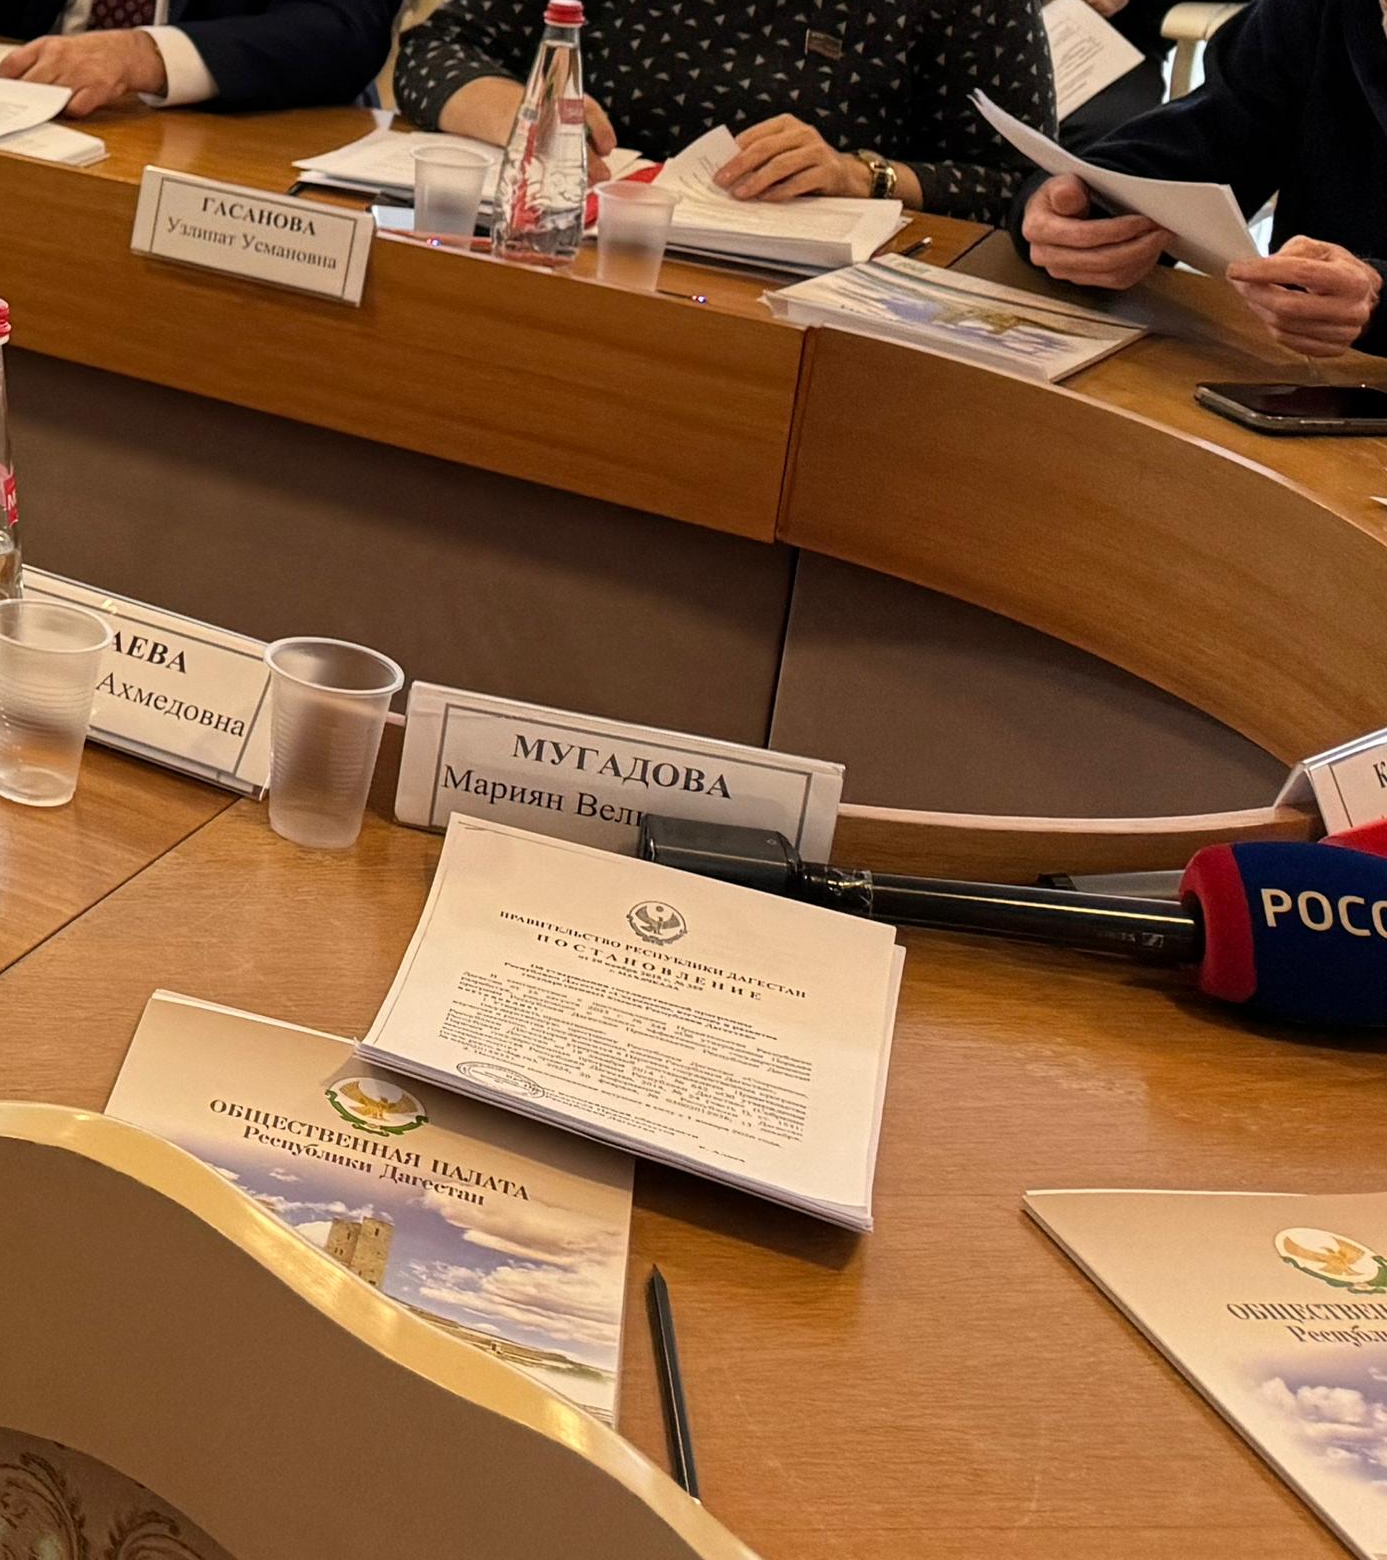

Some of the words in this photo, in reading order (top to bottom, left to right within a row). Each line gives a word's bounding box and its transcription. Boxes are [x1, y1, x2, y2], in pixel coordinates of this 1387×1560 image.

[167, 216, 237, 248] Узлипат
[242, 234, 337, 270] Усмановна
[201, 197, 317, 237] ГАСАНОВА
[95, 671, 247, 738] Ахмедовна
[440, 764, 564, 813] Мариян
[512, 734, 733, 800] МУГАДОВА
[499, 910, 621, 949] ПРАВИТЕЛЬСТВО
[626, 944, 723, 976] РЕСПУБЛИКИ
[727, 971, 807, 999] ДАГЕСТАН
[209, 1098, 422, 1169] ОБЩЕСТВЕННАЯ
[430, 1158, 531, 1202] ПАЛАТА
[242, 1124, 373, 1175] Республики
[379, 1163, 485, 1207] Дагестан
